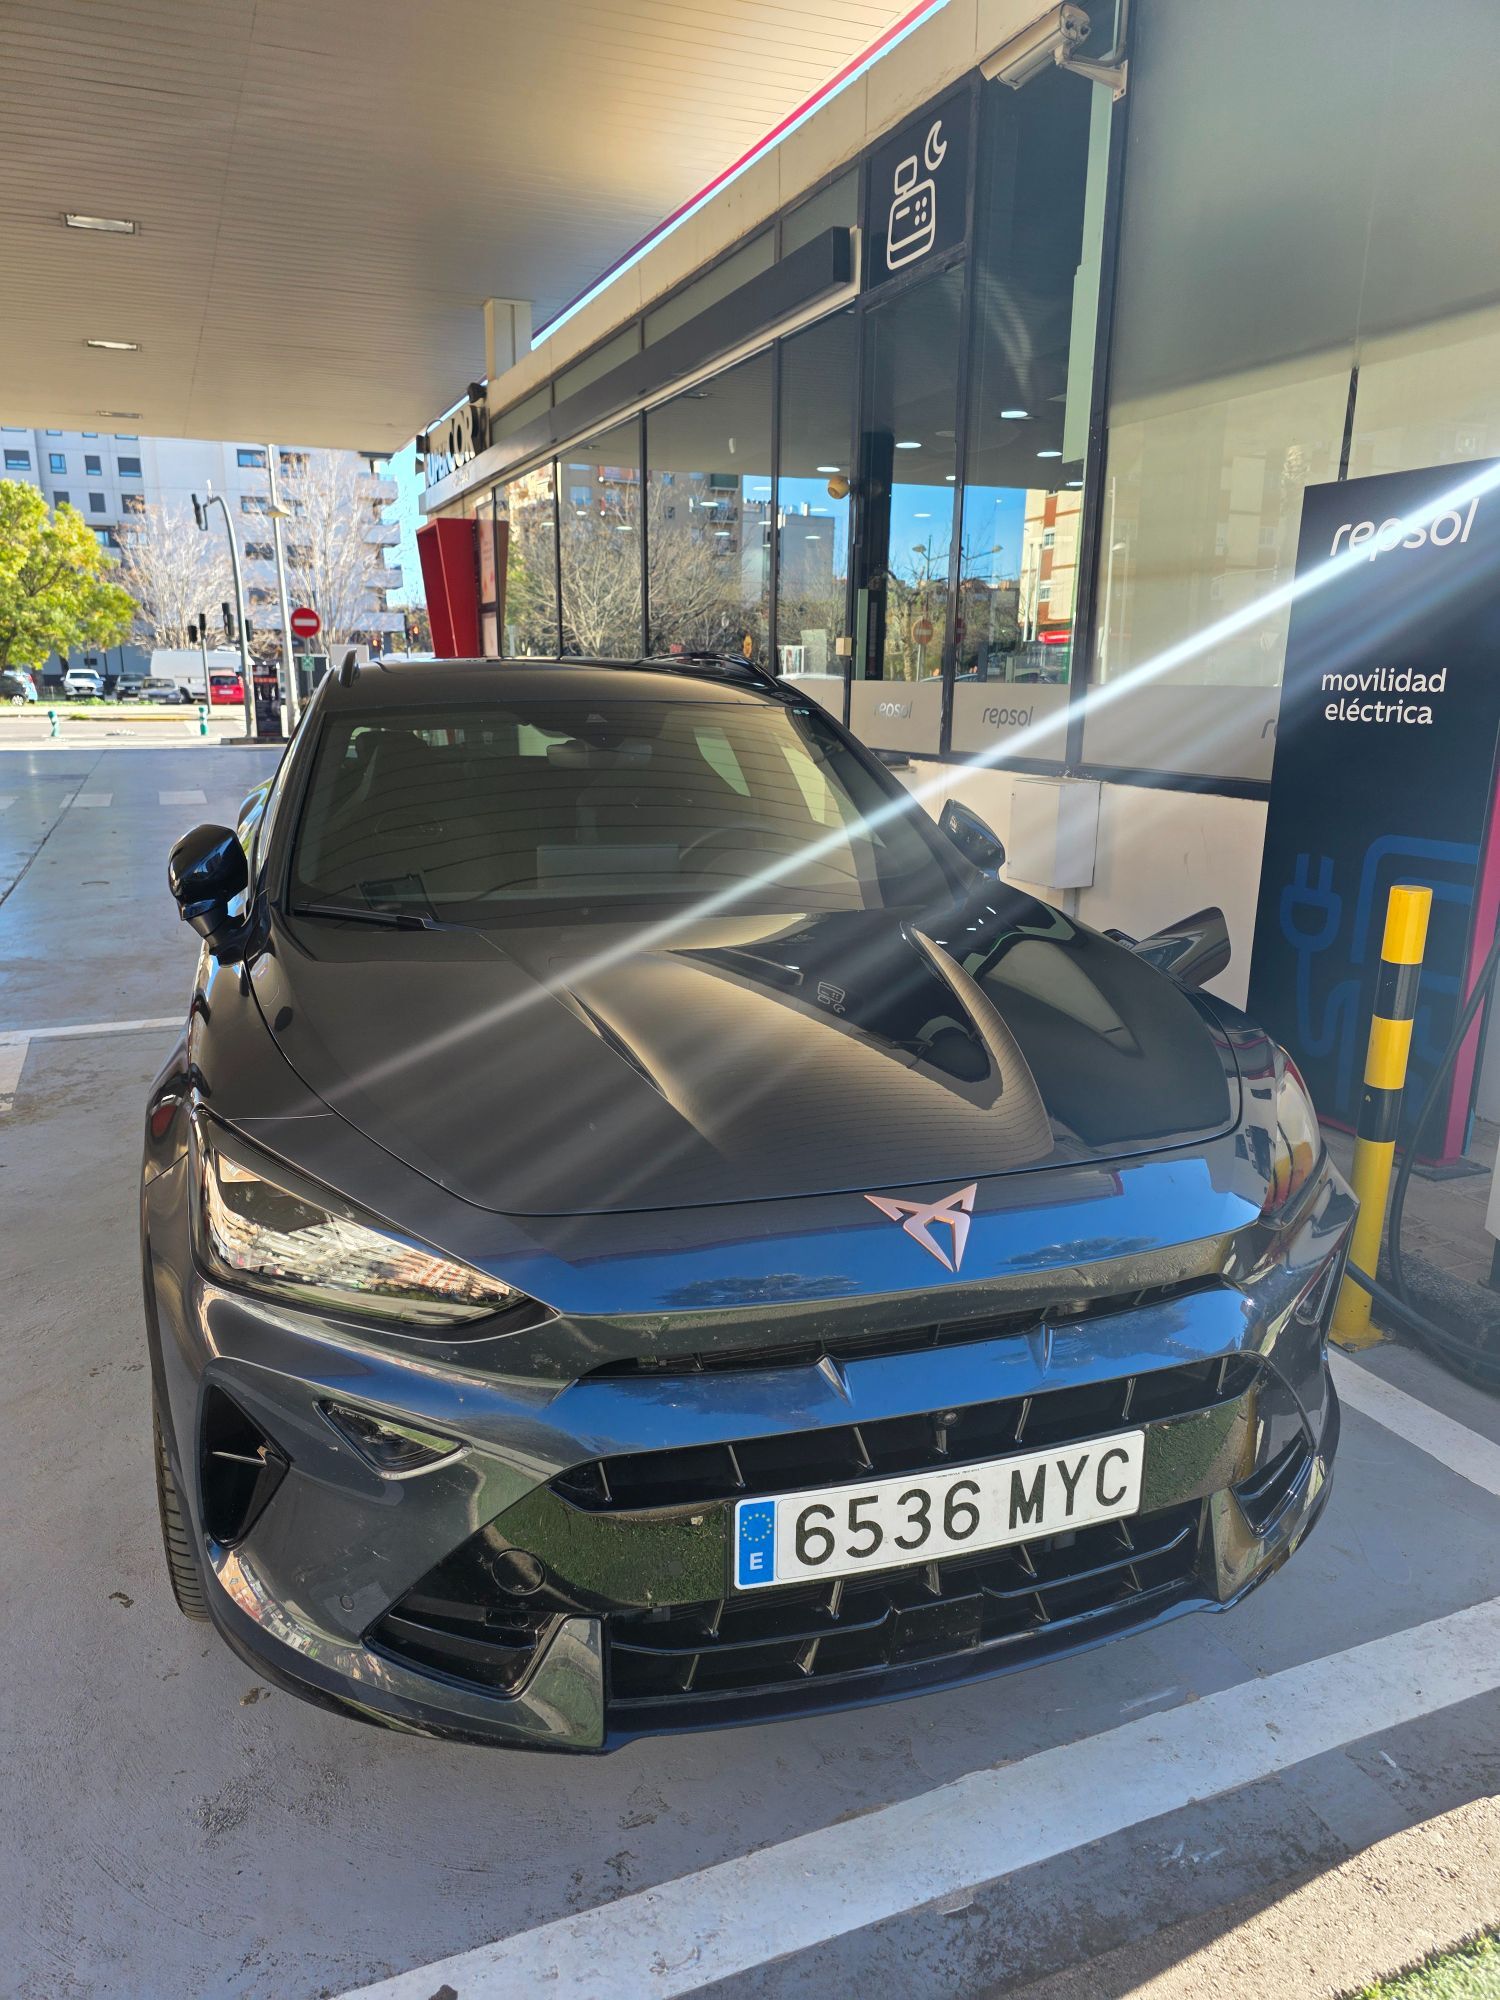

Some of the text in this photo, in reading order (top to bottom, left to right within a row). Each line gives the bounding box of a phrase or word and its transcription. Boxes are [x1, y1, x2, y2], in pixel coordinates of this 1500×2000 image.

[1329, 497, 1480, 562] repsol
[1321, 667, 1447, 693] movilidad
[982, 706, 1034, 729] repsol
[1324, 697, 1433, 725] eléctrica
[795, 1448, 1130, 1566] 6536 MYC
[749, 1552, 764, 1571] E
